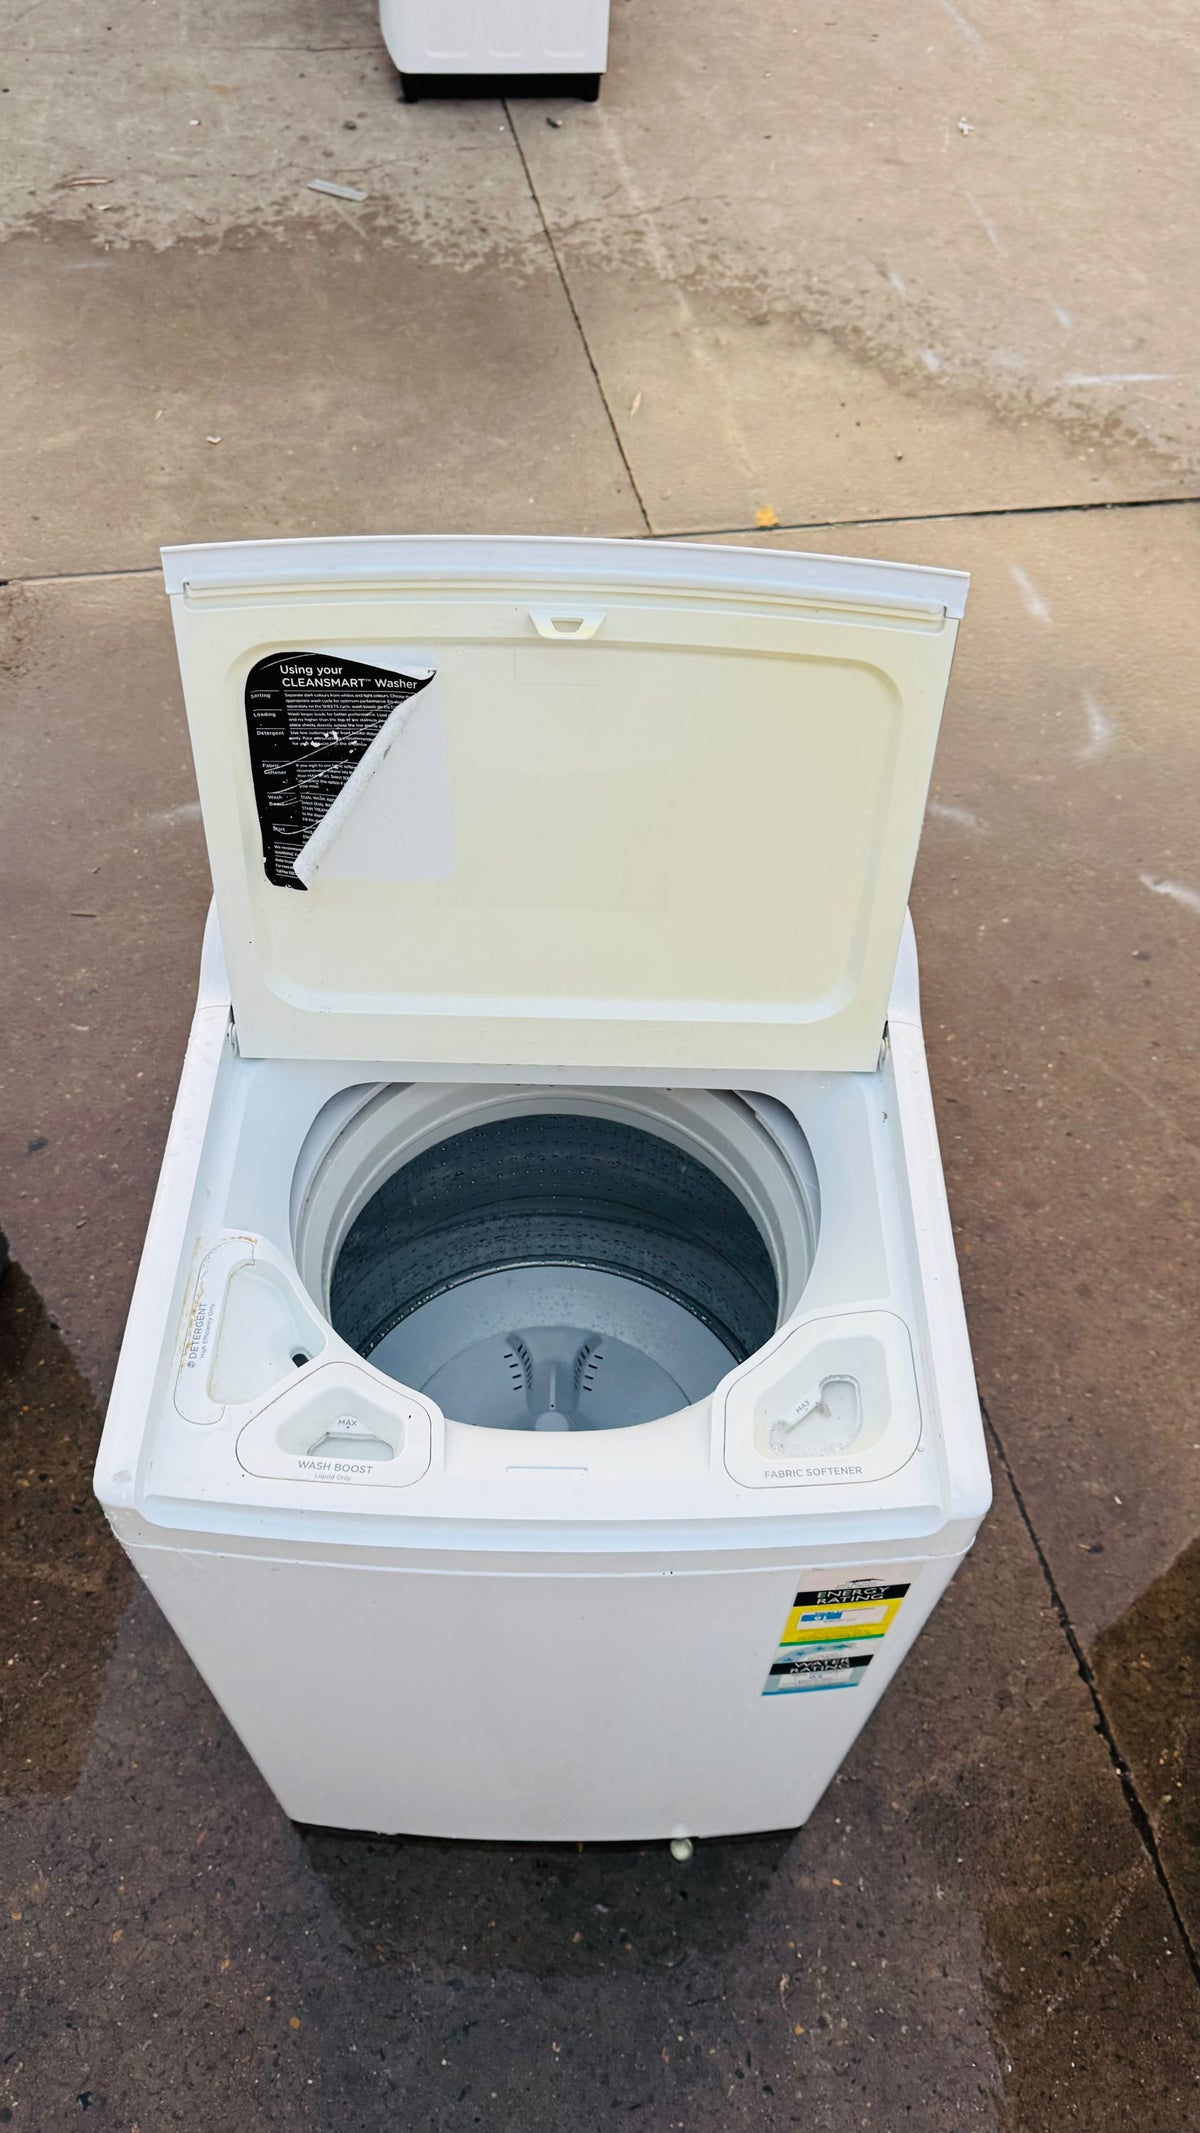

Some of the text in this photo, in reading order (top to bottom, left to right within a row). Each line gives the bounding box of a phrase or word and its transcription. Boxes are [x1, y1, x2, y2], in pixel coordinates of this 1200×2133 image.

[279, 665, 343, 676] Using your
[376, 679, 418, 689] Washer
[250, 692, 271, 700] Sorting
[188, 1302, 207, 1359] DETERGENT
[199, 1303, 216, 1359] High Efficiency Only
[796, 1399, 812, 1414] MAX
[298, 1460, 374, 1474] WASH BOOST
[764, 1466, 863, 1479] FABRIC SOFTENER
[336, 1474, 352, 1482] Only
[816, 1586, 890, 1599] ENERGY
[816, 1594, 884, 1605] RATING
[794, 1657, 850, 1668] WATER
[790, 1663, 851, 1674] RATING
